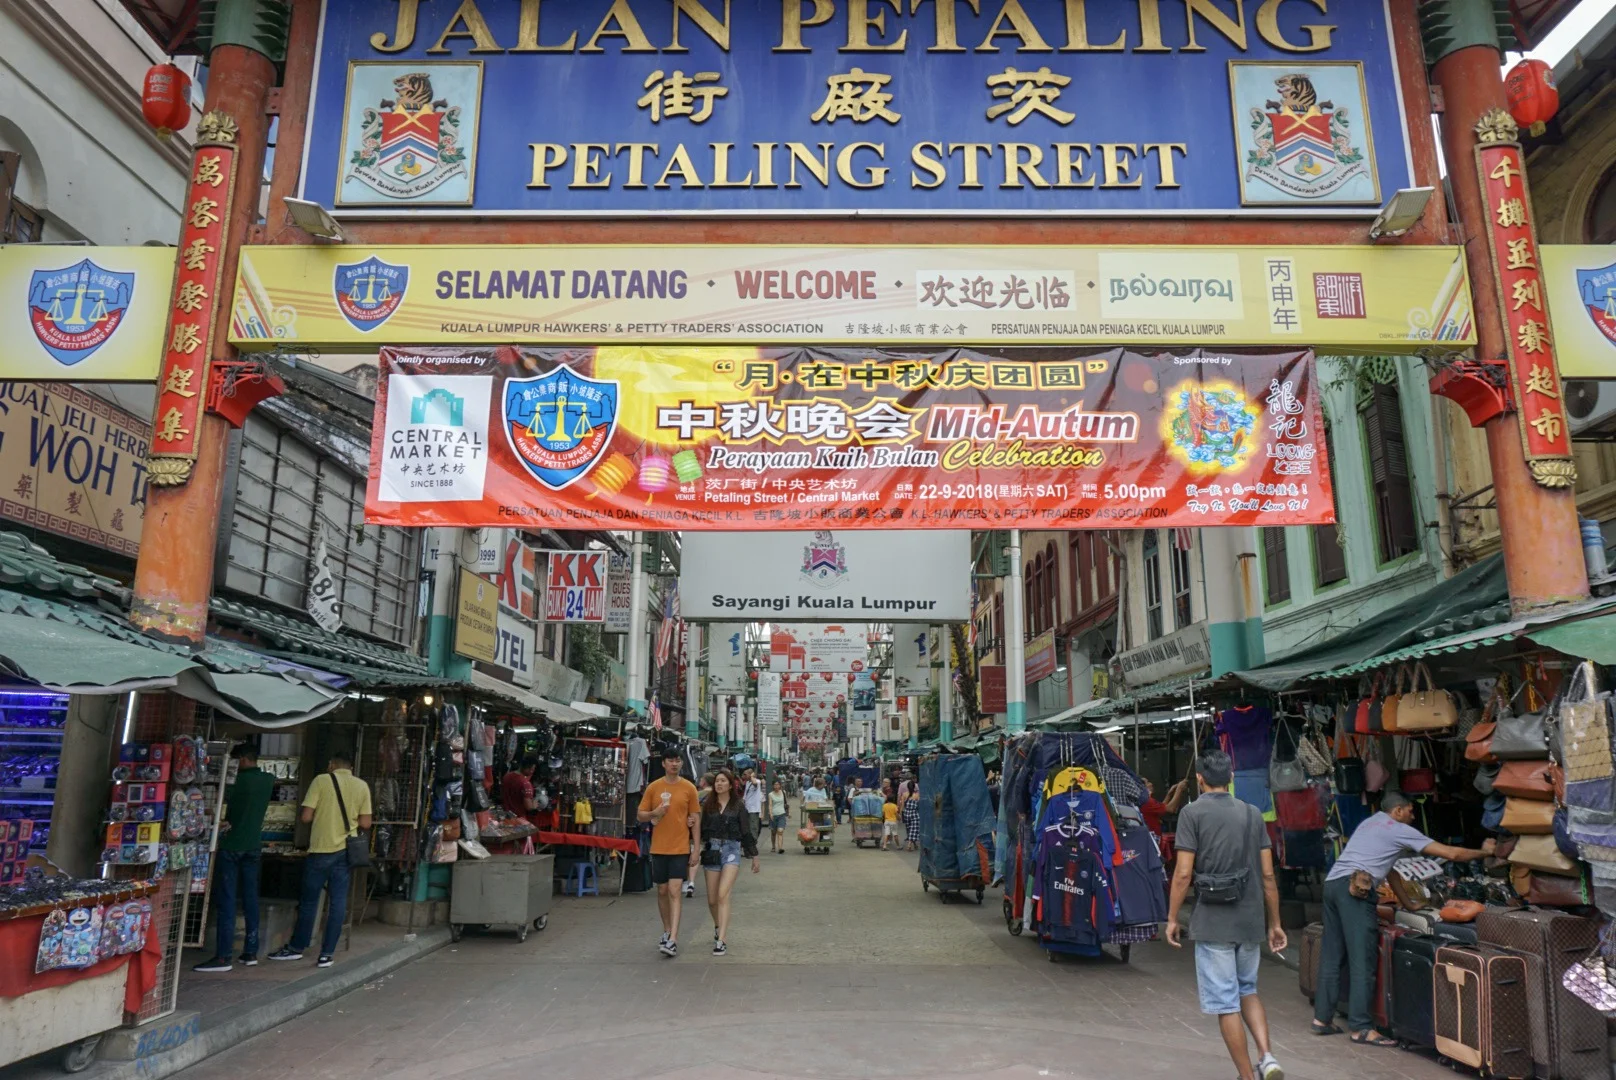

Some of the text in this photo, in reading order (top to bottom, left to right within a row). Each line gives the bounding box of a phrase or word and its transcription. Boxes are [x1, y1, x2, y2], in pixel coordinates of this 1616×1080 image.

[370, 0, 1338, 54] JALAN PETALING
[526, 141, 1187, 191] PETALING STREET
[355, 163, 461, 195] Dewan Bandaraya Kuala Lumpur
[1255, 163, 1361, 194] Dewan Bandaraya Kuala Lumpur
[436, 270, 1072, 310] SELAMAT DATANG WELCOME 欢迎光临
[1109, 273, 1234, 303] நல்வரவு
[1267, 260, 1298, 331] 丙申年
[49, 328, 101, 342] KUALA LUMPUR
[441, 323, 824, 333] KUALA LUMPUR HAWKERS' & PETTY TRADERS' ASSOCIATION
[991, 323, 1225, 335] PERSATUAN PENJAJA DAN PENIAGA KECIL KUALA LUMPUR
[59, 341, 79, 349] PETTY
[394, 356, 487, 366] Jointly organised by
[1174, 357, 1232, 366] Sponsored by
[658, 402, 912, 439] 中秋晚会
[929, 403, 1137, 441] Mid-Autum
[60, 404, 96, 435] JELI
[104, 424, 148, 460] HERB
[391, 429, 482, 445] CENTRAL
[390, 445, 482, 459] MARKET
[532, 443, 588, 461] KUALA LUMPUR
[544, 460, 567, 468] PETTY
[592, 431, 605, 451] ASSN.
[549, 442, 570, 450] 1953
[30, 416, 119, 496] WOH
[709, 446, 938, 471] Perayaan Kuih Bulan
[943, 440, 1103, 471] Celebration
[400, 462, 467, 476] 中央艺术坊
[410, 479, 454, 488] SINCE 1888
[705, 478, 757, 490] 茨厂街
[772, 478, 858, 491] 中央艺术坊
[705, 492, 751, 505] Petaling
[754, 492, 788, 503] Street
[797, 492, 838, 503] Central
[841, 491, 880, 502] Market
[1104, 483, 1167, 501] 5.00pm
[498, 505, 745, 521] PERSATUAN PENJAJA DAN PENIAGA KECIL K.L.
[993, 508, 1001, 519] &
[1003, 508, 1037, 519] PETTY
[1095, 507, 1168, 519] ASSOCIATION
[1187, 501, 1208, 513] Try
[1261, 500, 1285, 511] Love
[552, 553, 602, 587] KK
[613, 583, 630, 594] GUES
[547, 590, 604, 618] BUKA 24 JAM
[611, 597, 630, 608] HOUS
[712, 594, 937, 612] Sayangi Kuala Lumpur
[1054, 881, 1084, 895] Emirates
[1065, 877, 1075, 885] Fly
